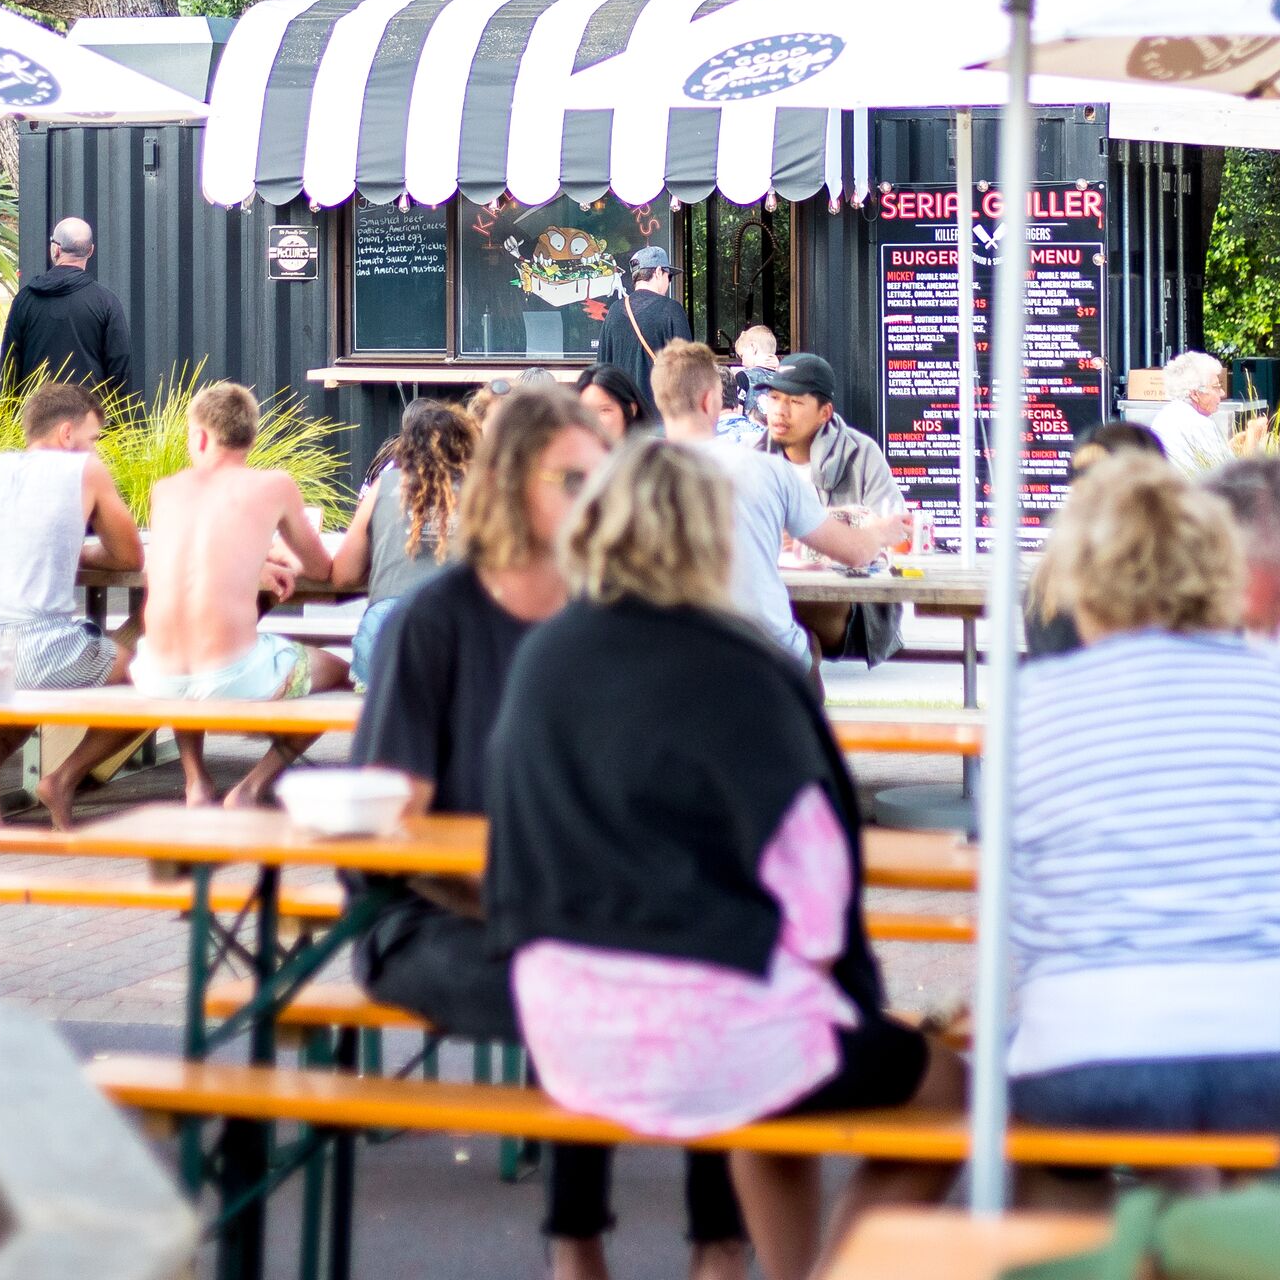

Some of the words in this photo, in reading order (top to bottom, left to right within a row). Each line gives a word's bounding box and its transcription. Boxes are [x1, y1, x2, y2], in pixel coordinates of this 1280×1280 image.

[735, 46, 807, 67] GOOD
[701, 48, 833, 94] George
[982, 190, 1103, 220] GILLER
[360, 216, 399, 227] Smashed
[358, 236, 383, 244] onion,
[385, 234, 405, 242] fried
[407, 234, 426, 244] egg,
[1030, 249, 1081, 265] MENU
[356, 256, 384, 268] tomato
[414, 255, 438, 264] mayo
[356, 268, 370, 276] and
[374, 266, 408, 274] American
[887, 271, 915, 281] MICKEY
[1037, 272, 1059, 280] DOUBLE
[1060, 272, 1080, 280] SMASH
[887, 282, 901, 290] BEEF
[926, 282, 956, 290] AMERICAN
[1040, 281, 1070, 289] AMERICAN
[1070, 281, 1094, 289] CHEESE,
[887, 299, 911, 307] PICKLES
[912, 299, 916, 307] &
[917, 299, 939, 307] MICKEY
[939, 299, 958, 307] SAUCE
[1077, 307, 1096, 318] $17
[914, 316, 943, 324] SOUTHERN
[888, 325, 916, 333] AMERICAN
[917, 325, 939, 333] CHEESE,
[1025, 324, 1047, 332] DOUBLE
[1047, 324, 1066, 332] SMASH
[1066, 324, 1079, 332] BEEF
[1051, 334, 1073, 342] CHEESE,
[888, 343, 893, 351] &
[894, 343, 914, 351] MICKEY
[914, 343, 933, 351] SAUCE
[888, 360, 917, 370] DWIGHT
[917, 361, 935, 369] BLACK
[1039, 359, 1064, 367] KETCHUP
[888, 379, 913, 387] LETTUCE,
[888, 387, 911, 395] PICKLES
[911, 387, 916, 395] &
[917, 387, 938, 395] MICKEY
[938, 387, 956, 395] SAUCE
[1040, 386, 1049, 394] $3
[1082, 386, 1099, 394] FREE
[1028, 395, 1037, 403] $2
[923, 410, 942, 419] CHECK
[942, 410, 953, 419] THE
[1021, 409, 1063, 420] PECIALS
[913, 420, 942, 432] KIDS
[1032, 421, 1069, 433] SIDES
[888, 433, 902, 441] KIDS
[903, 433, 925, 441] MICKEY
[926, 449, 943, 457] PICKLE
[1031, 451, 1057, 460] CHICKEN
[1029, 459, 1054, 467] SOUTHERN
[903, 468, 926, 476] BURGER
[1030, 484, 1049, 493] WINGS
